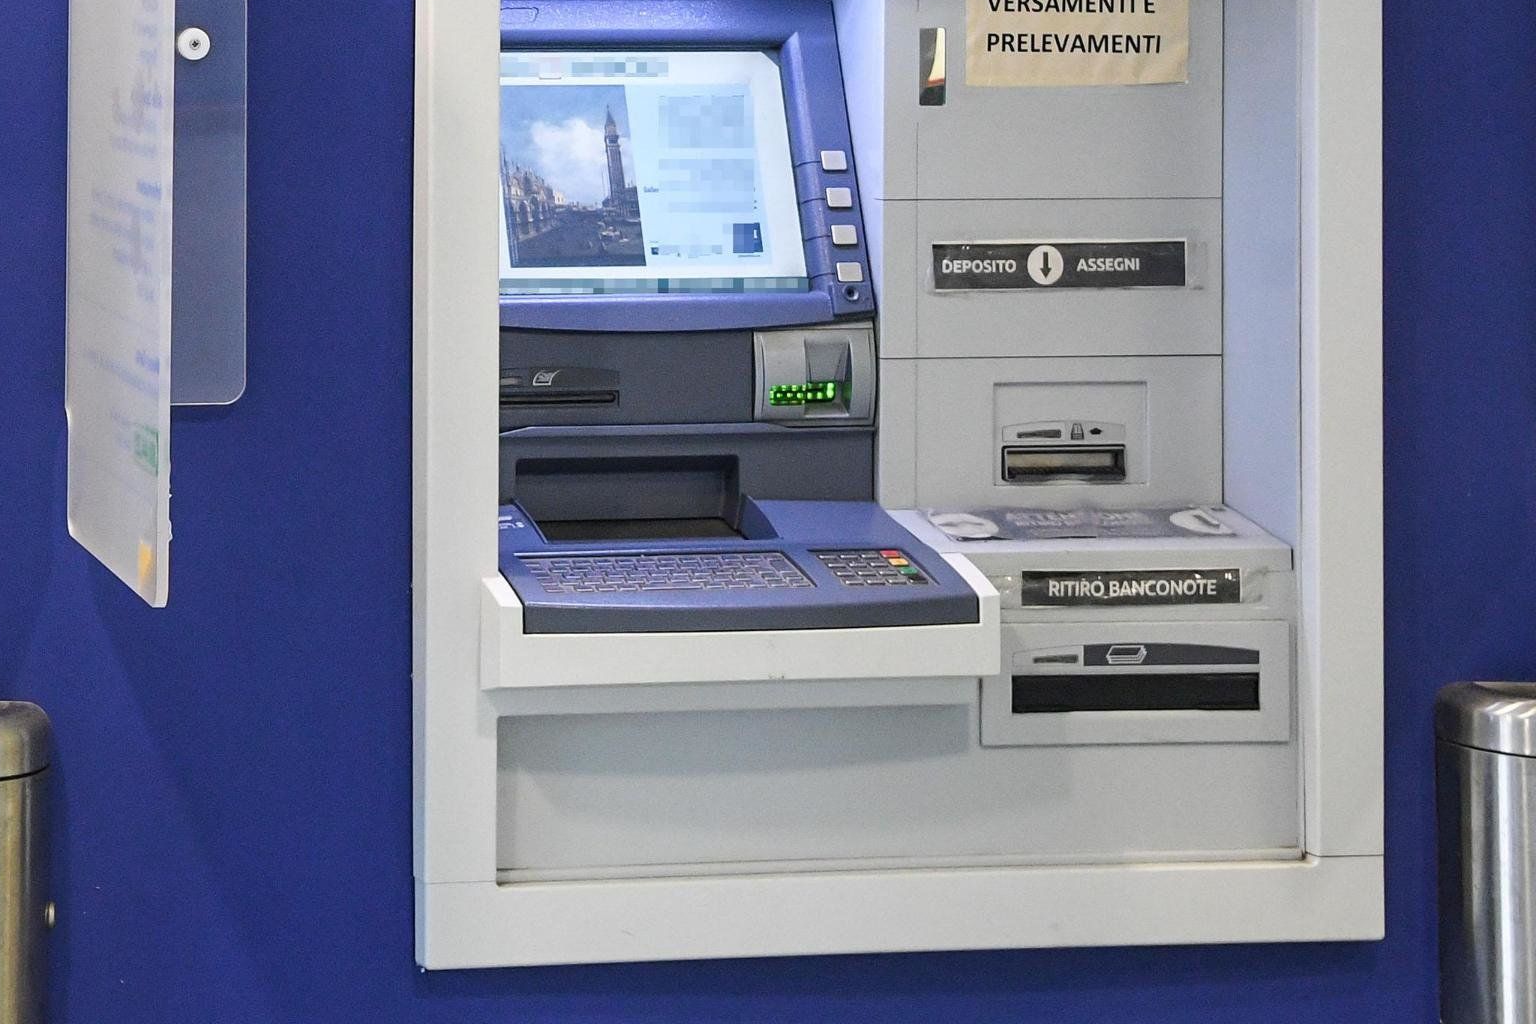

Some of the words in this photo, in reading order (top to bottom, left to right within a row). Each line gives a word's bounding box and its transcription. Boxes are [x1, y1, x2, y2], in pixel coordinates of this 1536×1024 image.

[986, 32, 1162, 55] PRELEVAMENTI
[941, 258, 1017, 274] DEPOSITO
[1076, 257, 1140, 272] ASSEGNI
[1048, 579, 1105, 597] RITIRO
[1109, 579, 1217, 596] BANCONOTE
